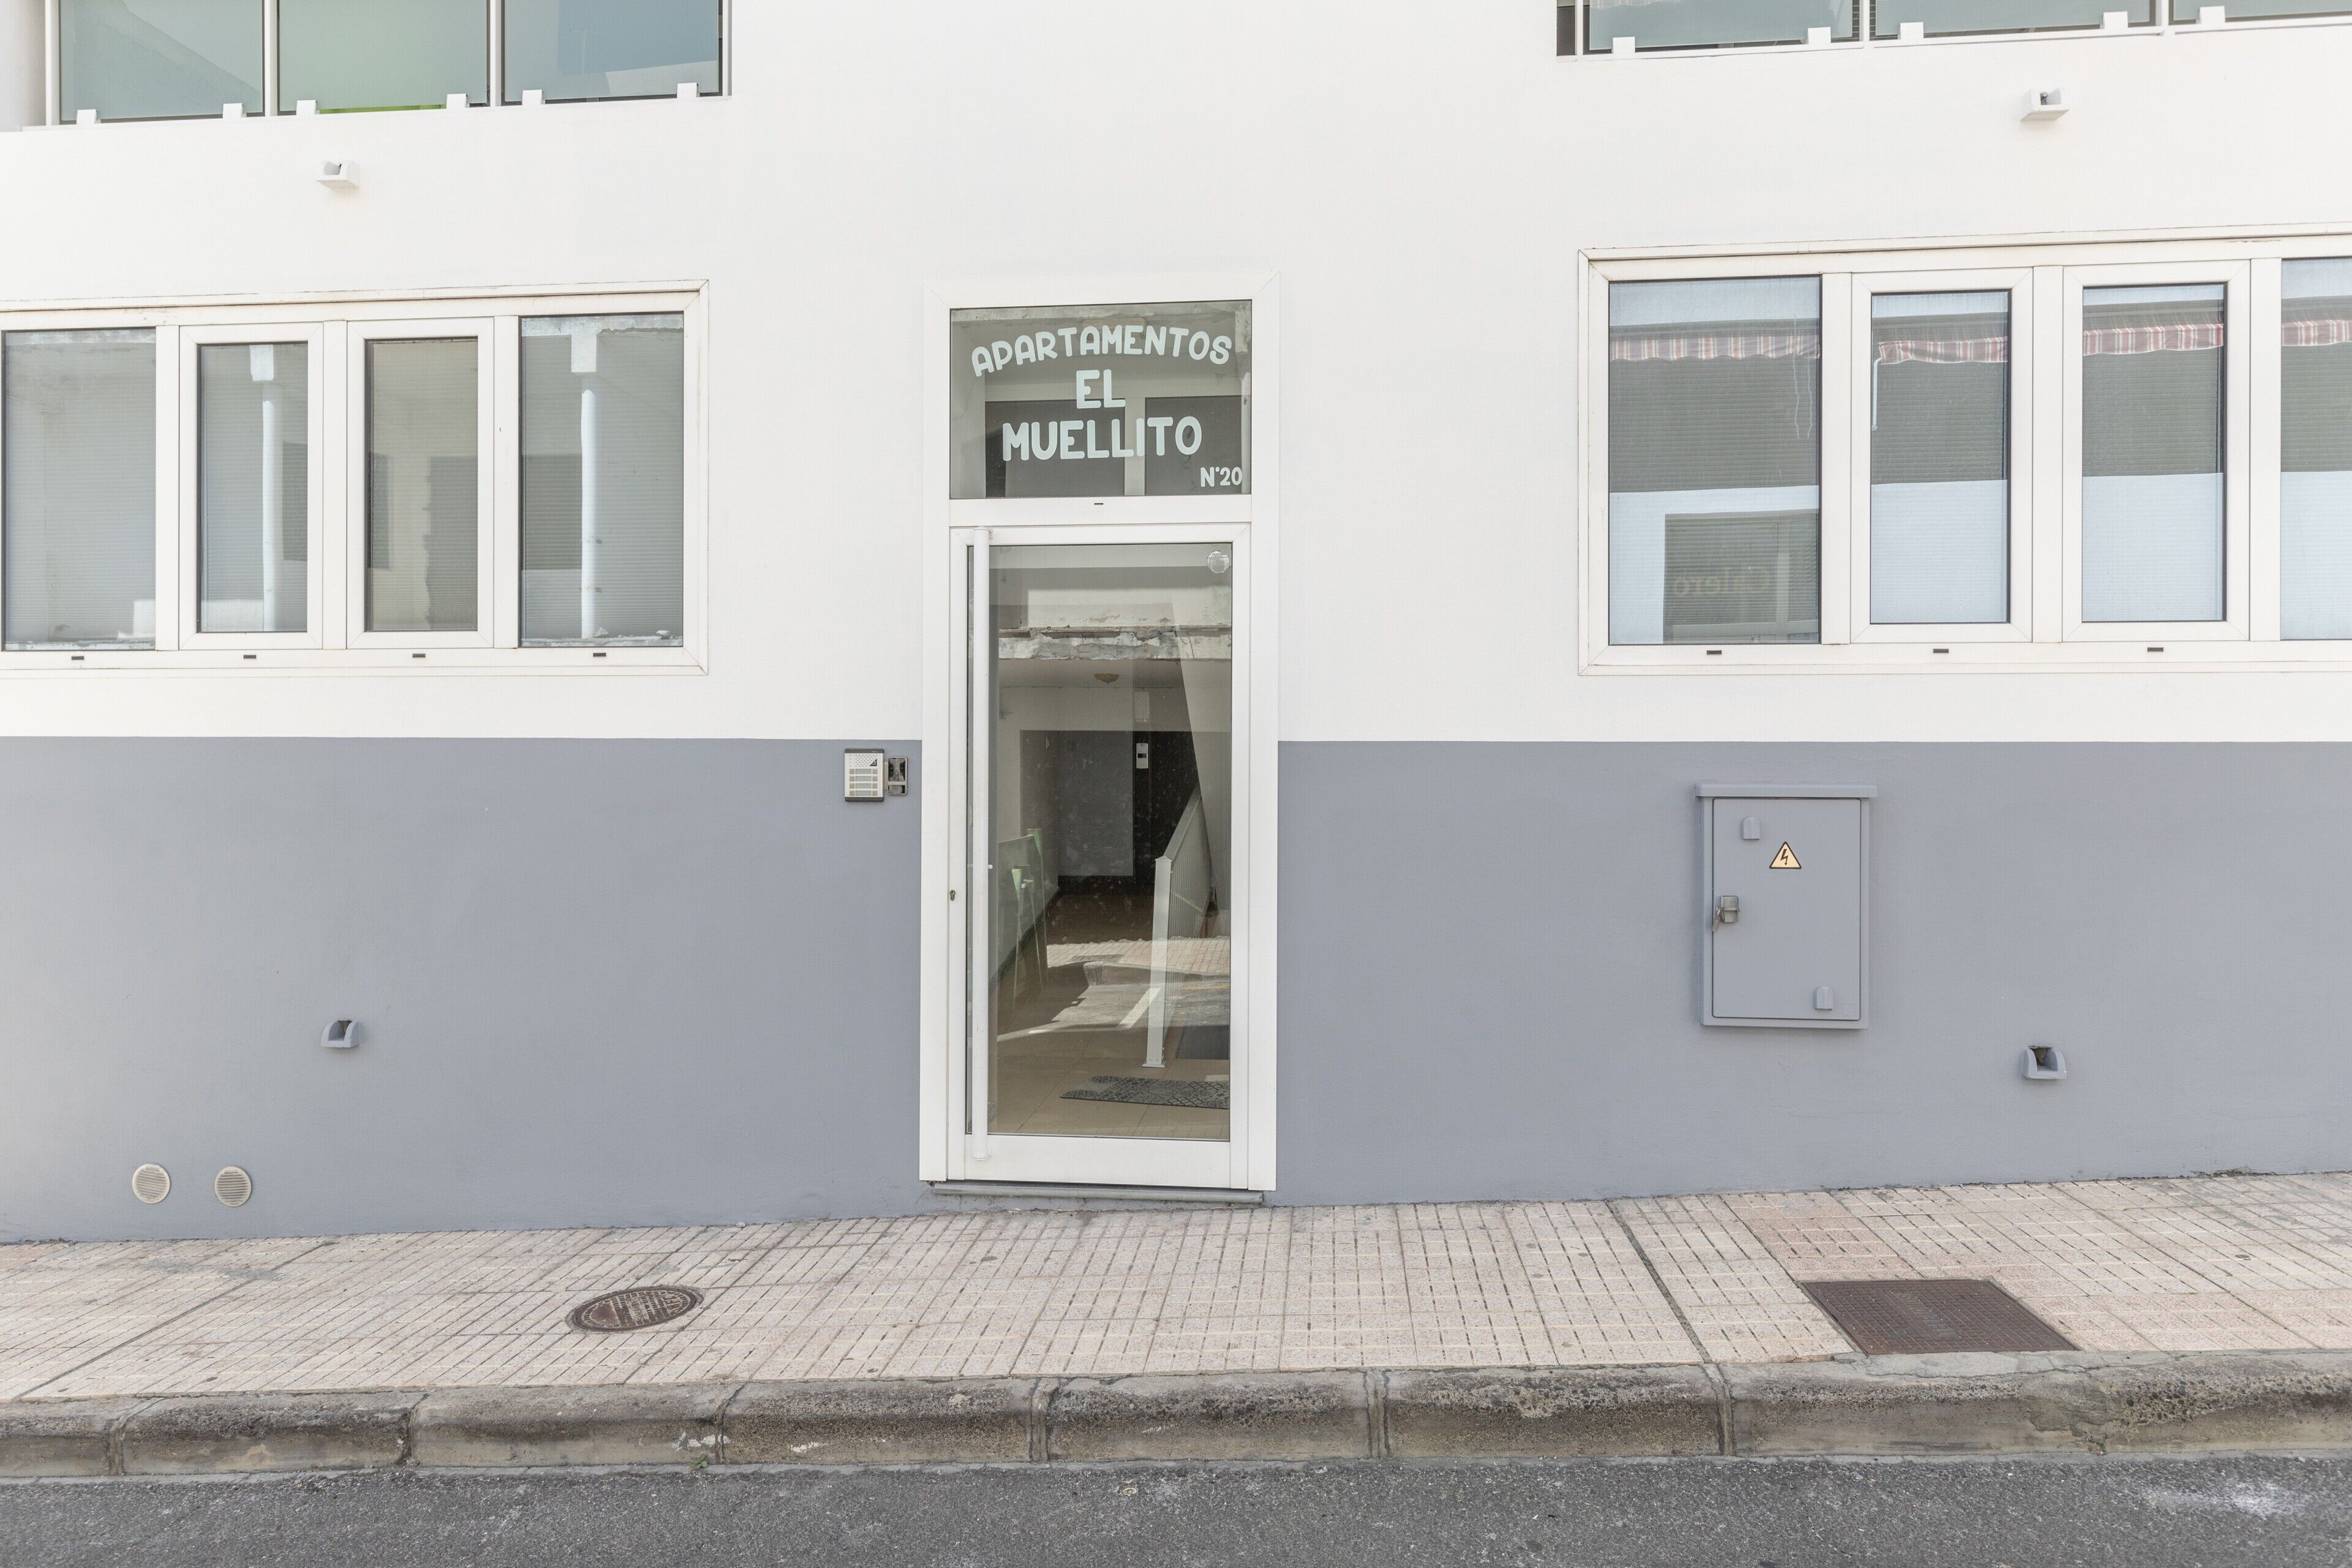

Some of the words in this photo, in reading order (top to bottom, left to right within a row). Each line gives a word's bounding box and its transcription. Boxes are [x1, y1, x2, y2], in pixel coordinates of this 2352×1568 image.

[971, 325, 1232, 377] APARTAMENTOS
[1076, 369, 1126, 409] EL
[1003, 416, 1202, 461] MUELLITO
